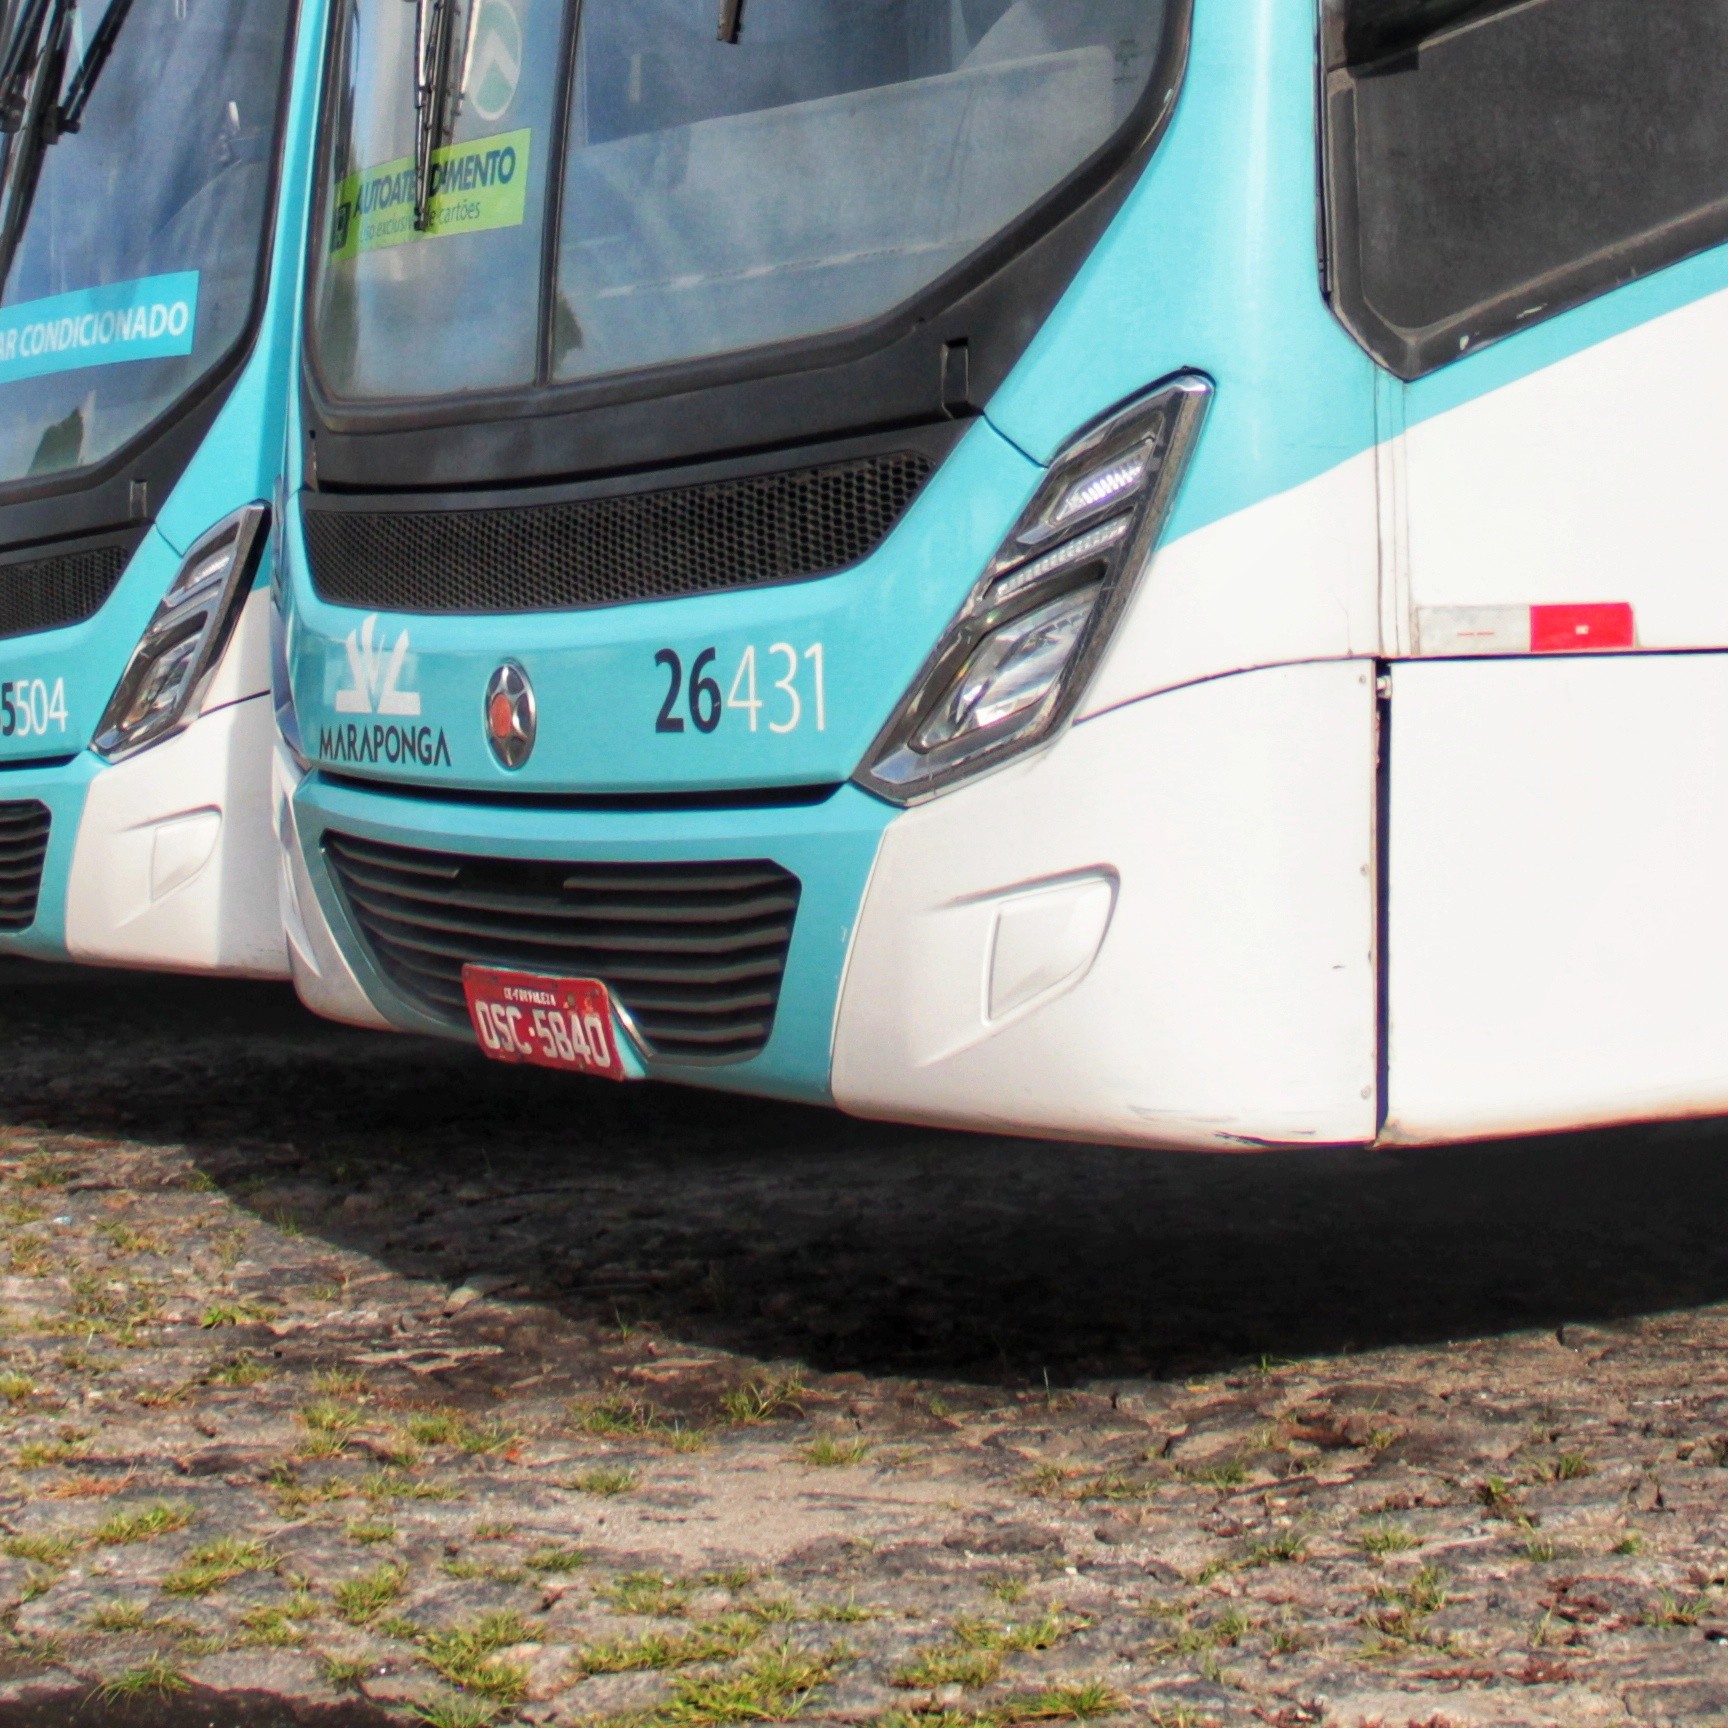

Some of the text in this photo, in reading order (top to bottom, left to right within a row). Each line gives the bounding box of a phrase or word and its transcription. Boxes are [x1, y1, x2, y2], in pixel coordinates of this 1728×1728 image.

[353, 146, 517, 218] AUTOATEDIMENTO
[376, 216, 422, 239] exclusiv
[440, 199, 481, 225] cartões
[21, 301, 189, 357] CONDICIONADO
[654, 642, 826, 734] 26431
[319, 723, 452, 767] MARAPONGA
